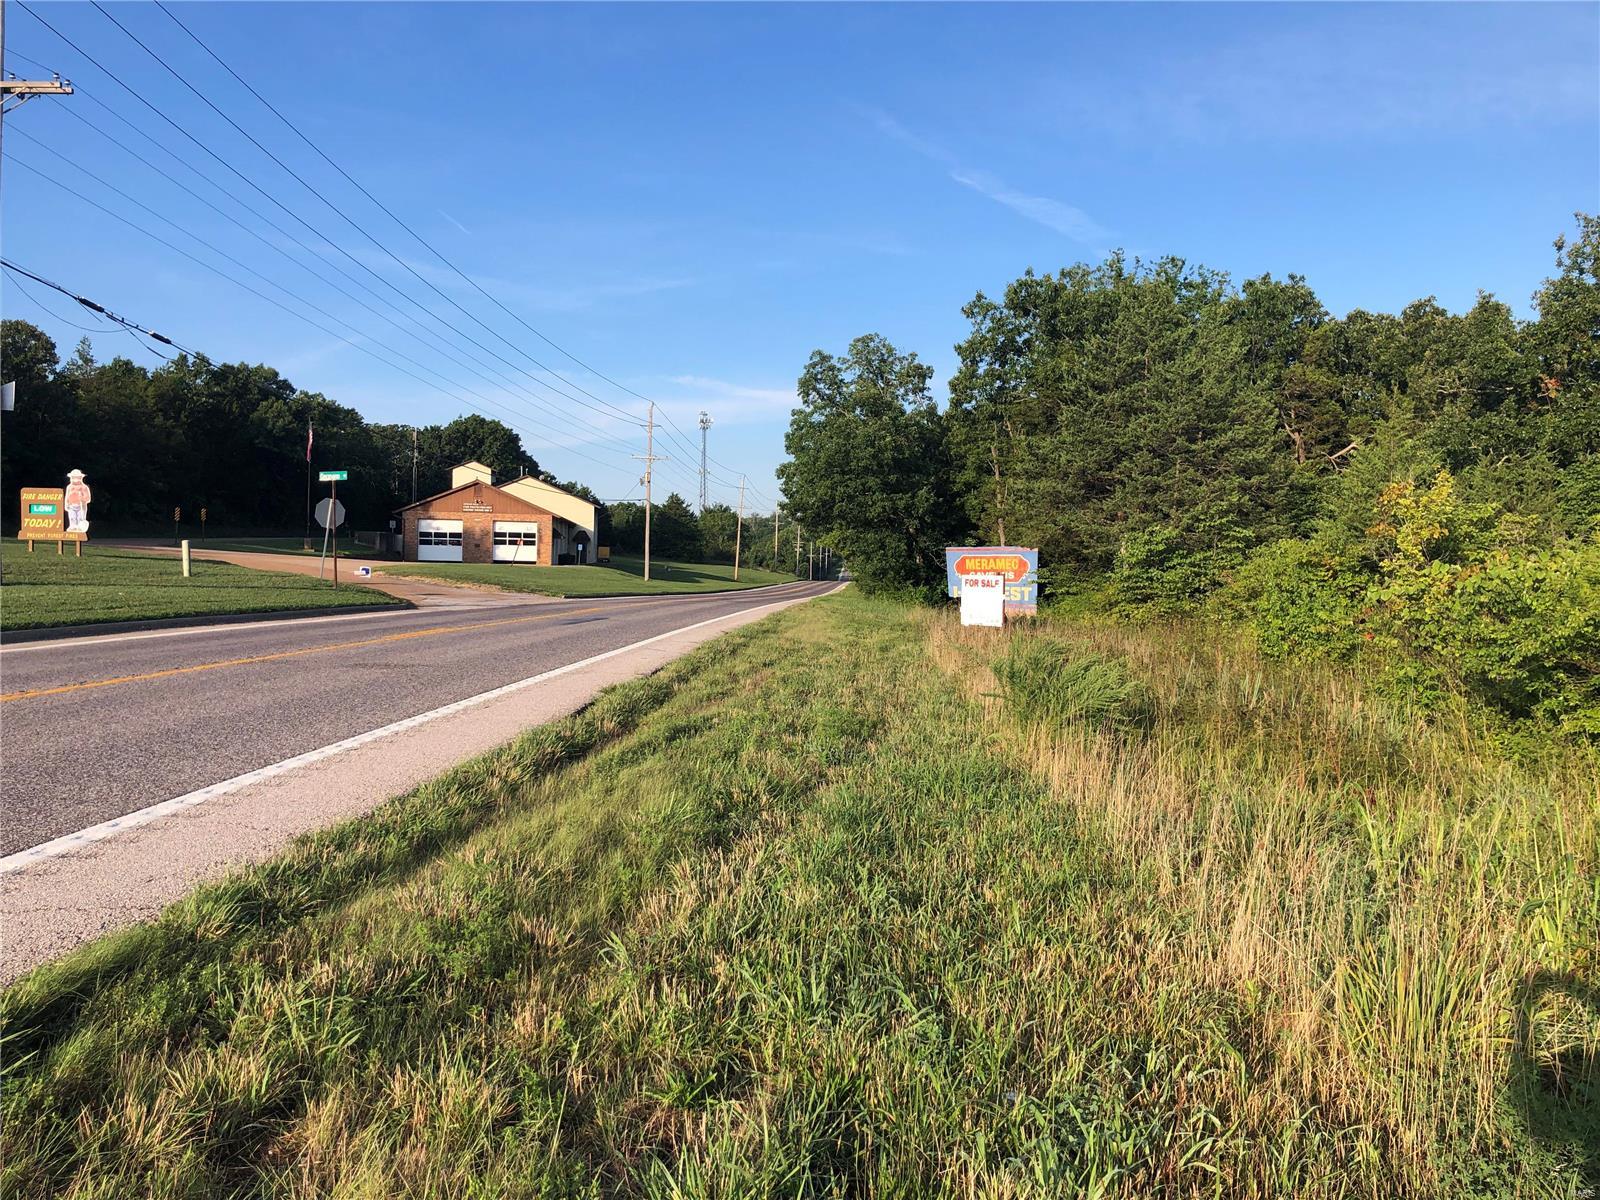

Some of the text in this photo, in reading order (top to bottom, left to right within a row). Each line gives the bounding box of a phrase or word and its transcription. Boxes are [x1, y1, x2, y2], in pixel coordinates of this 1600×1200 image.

[966, 558, 1019, 570] MERAMEC
[964, 579, 979, 588] FOR
[1004, 587, 1032, 601] EST
